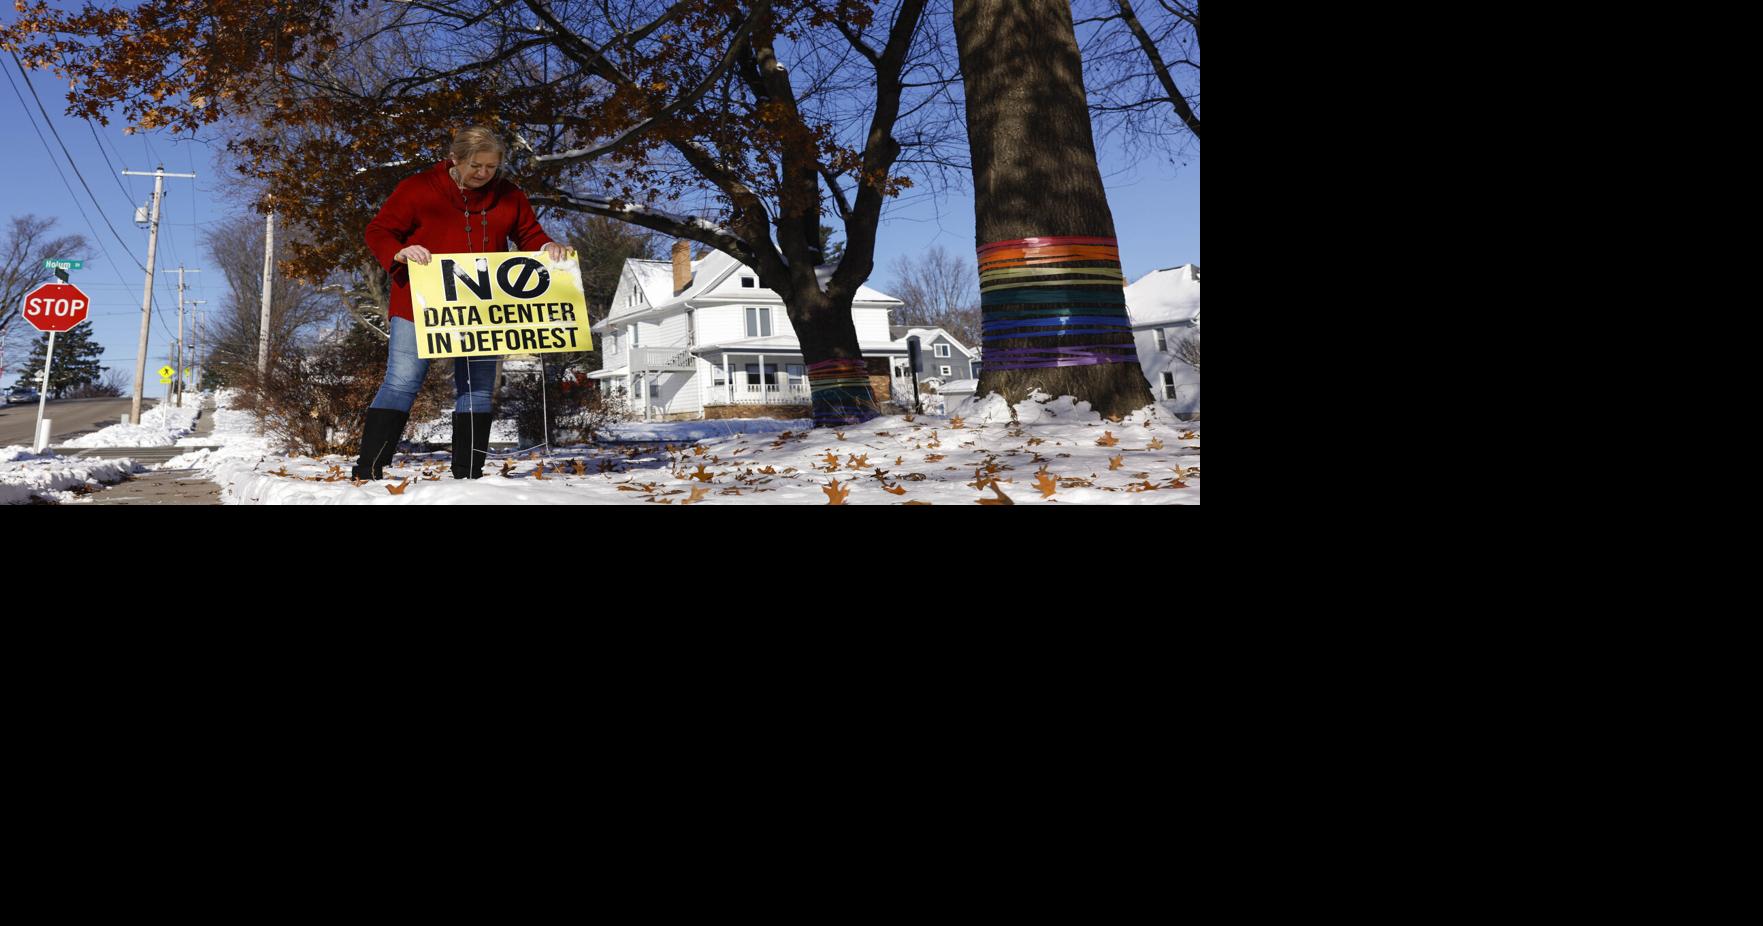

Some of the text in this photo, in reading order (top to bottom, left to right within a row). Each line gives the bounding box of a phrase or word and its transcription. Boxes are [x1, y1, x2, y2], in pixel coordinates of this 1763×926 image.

[441, 256, 550, 301] NO
[27, 297, 85, 317] STOP
[423, 303, 576, 327] DATA CENTER
[427, 327, 578, 354] IN DEFOREST
